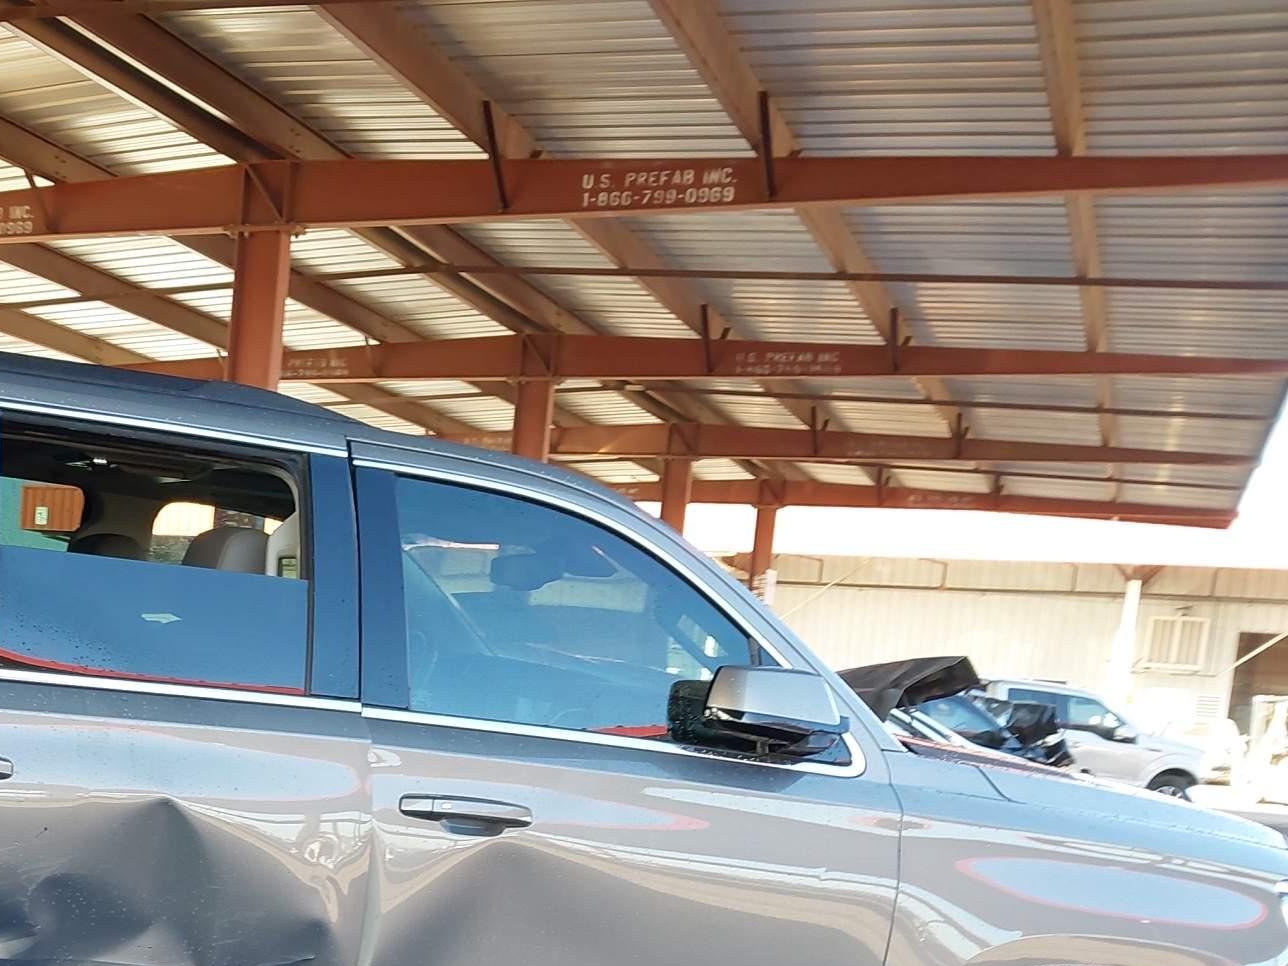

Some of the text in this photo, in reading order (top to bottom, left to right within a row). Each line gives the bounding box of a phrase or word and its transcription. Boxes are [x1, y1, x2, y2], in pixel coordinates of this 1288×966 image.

[624, 168, 696, 187] PREFAB
[702, 167, 739, 185] INC.
[581, 186, 736, 207] 1-866-799-0969
